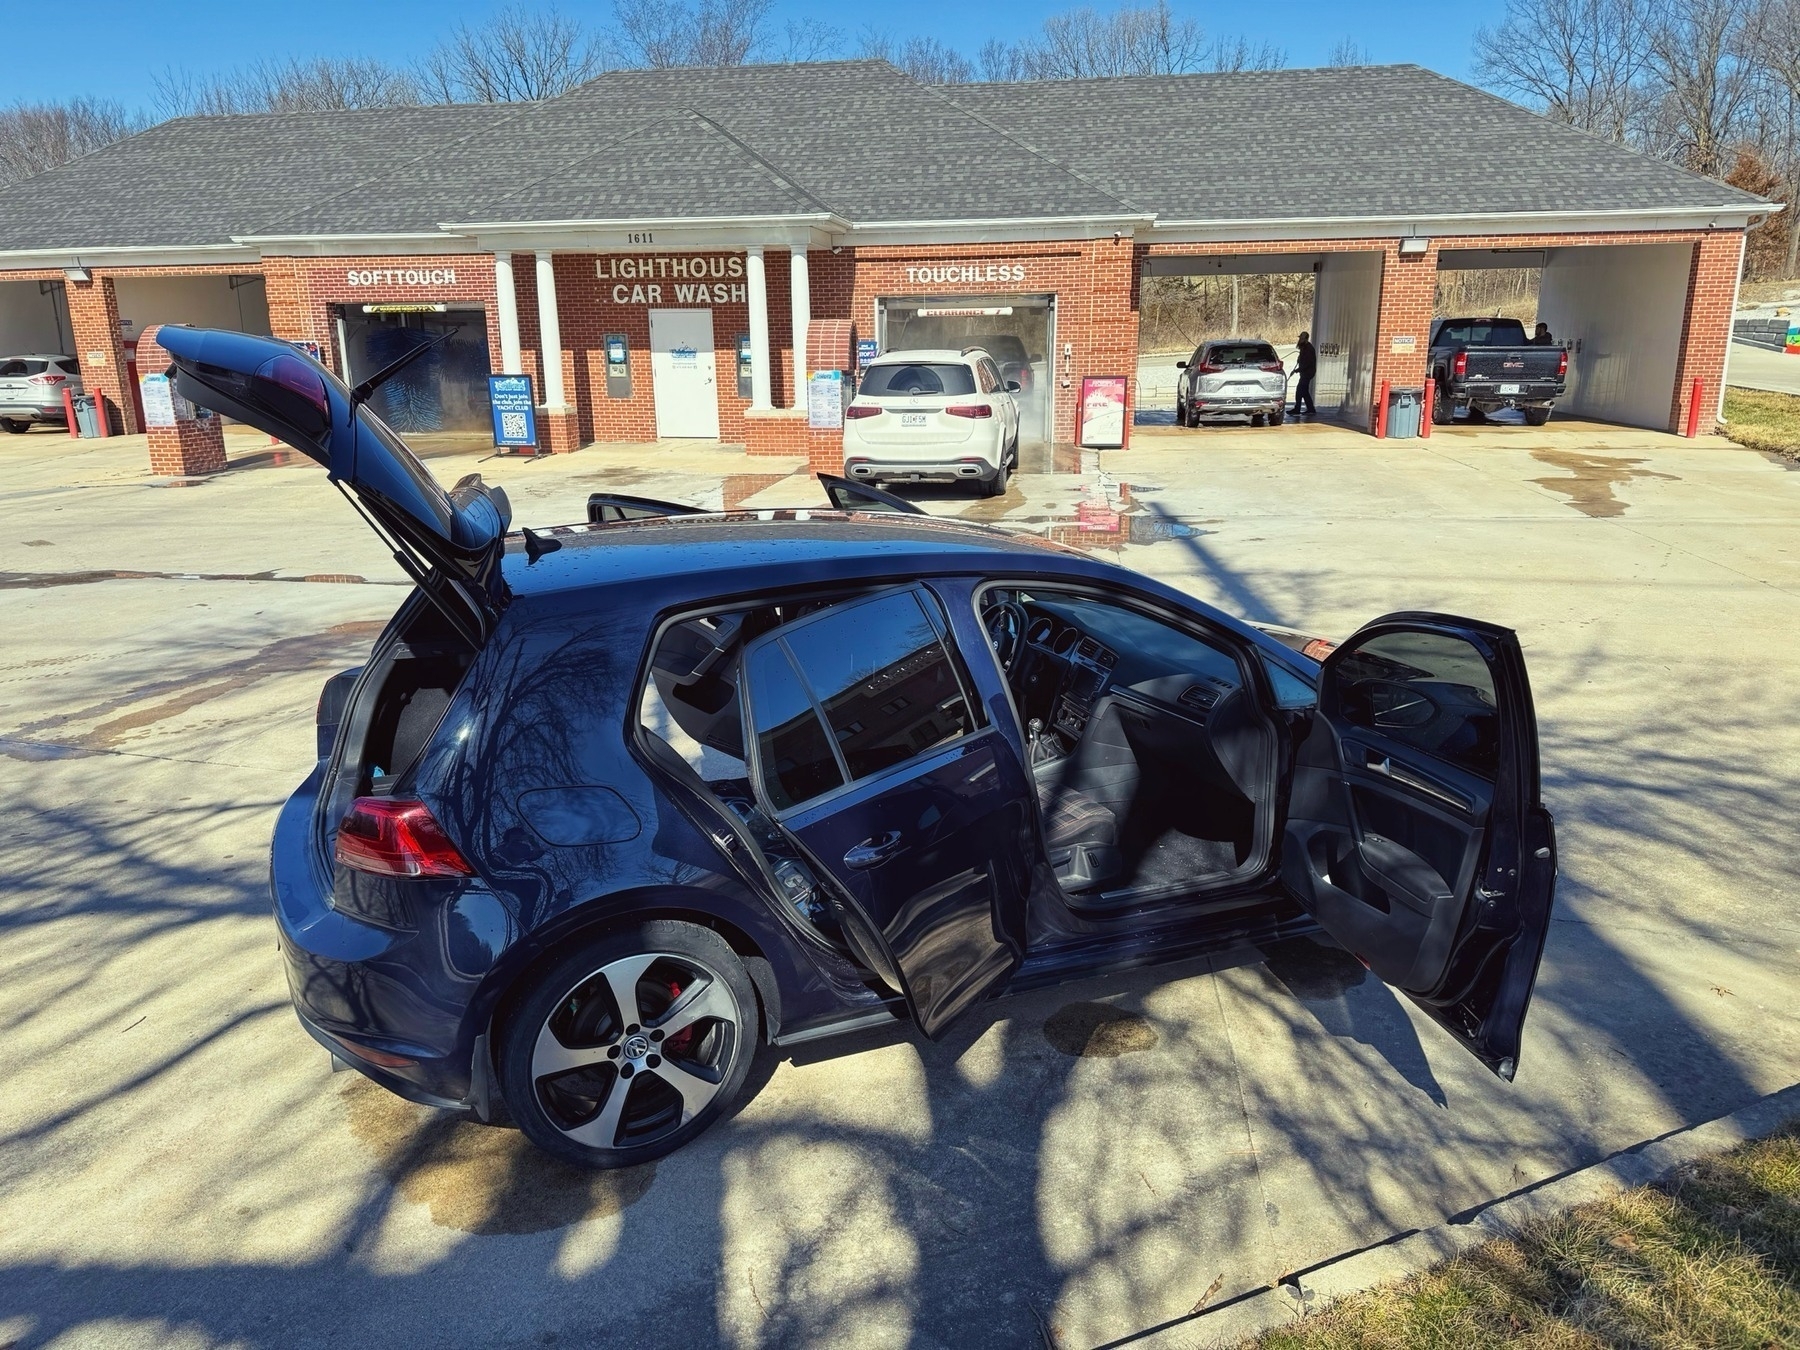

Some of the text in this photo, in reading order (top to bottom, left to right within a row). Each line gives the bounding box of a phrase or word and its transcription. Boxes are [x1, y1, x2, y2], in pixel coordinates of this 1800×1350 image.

[628, 233, 653, 243] 1611
[347, 269, 456, 286] SOFTTOUCH
[596, 257, 749, 279] LIGHTHOUS
[906, 264, 1025, 283] TOUCHLESS
[613, 283, 746, 304] CAR WASH
